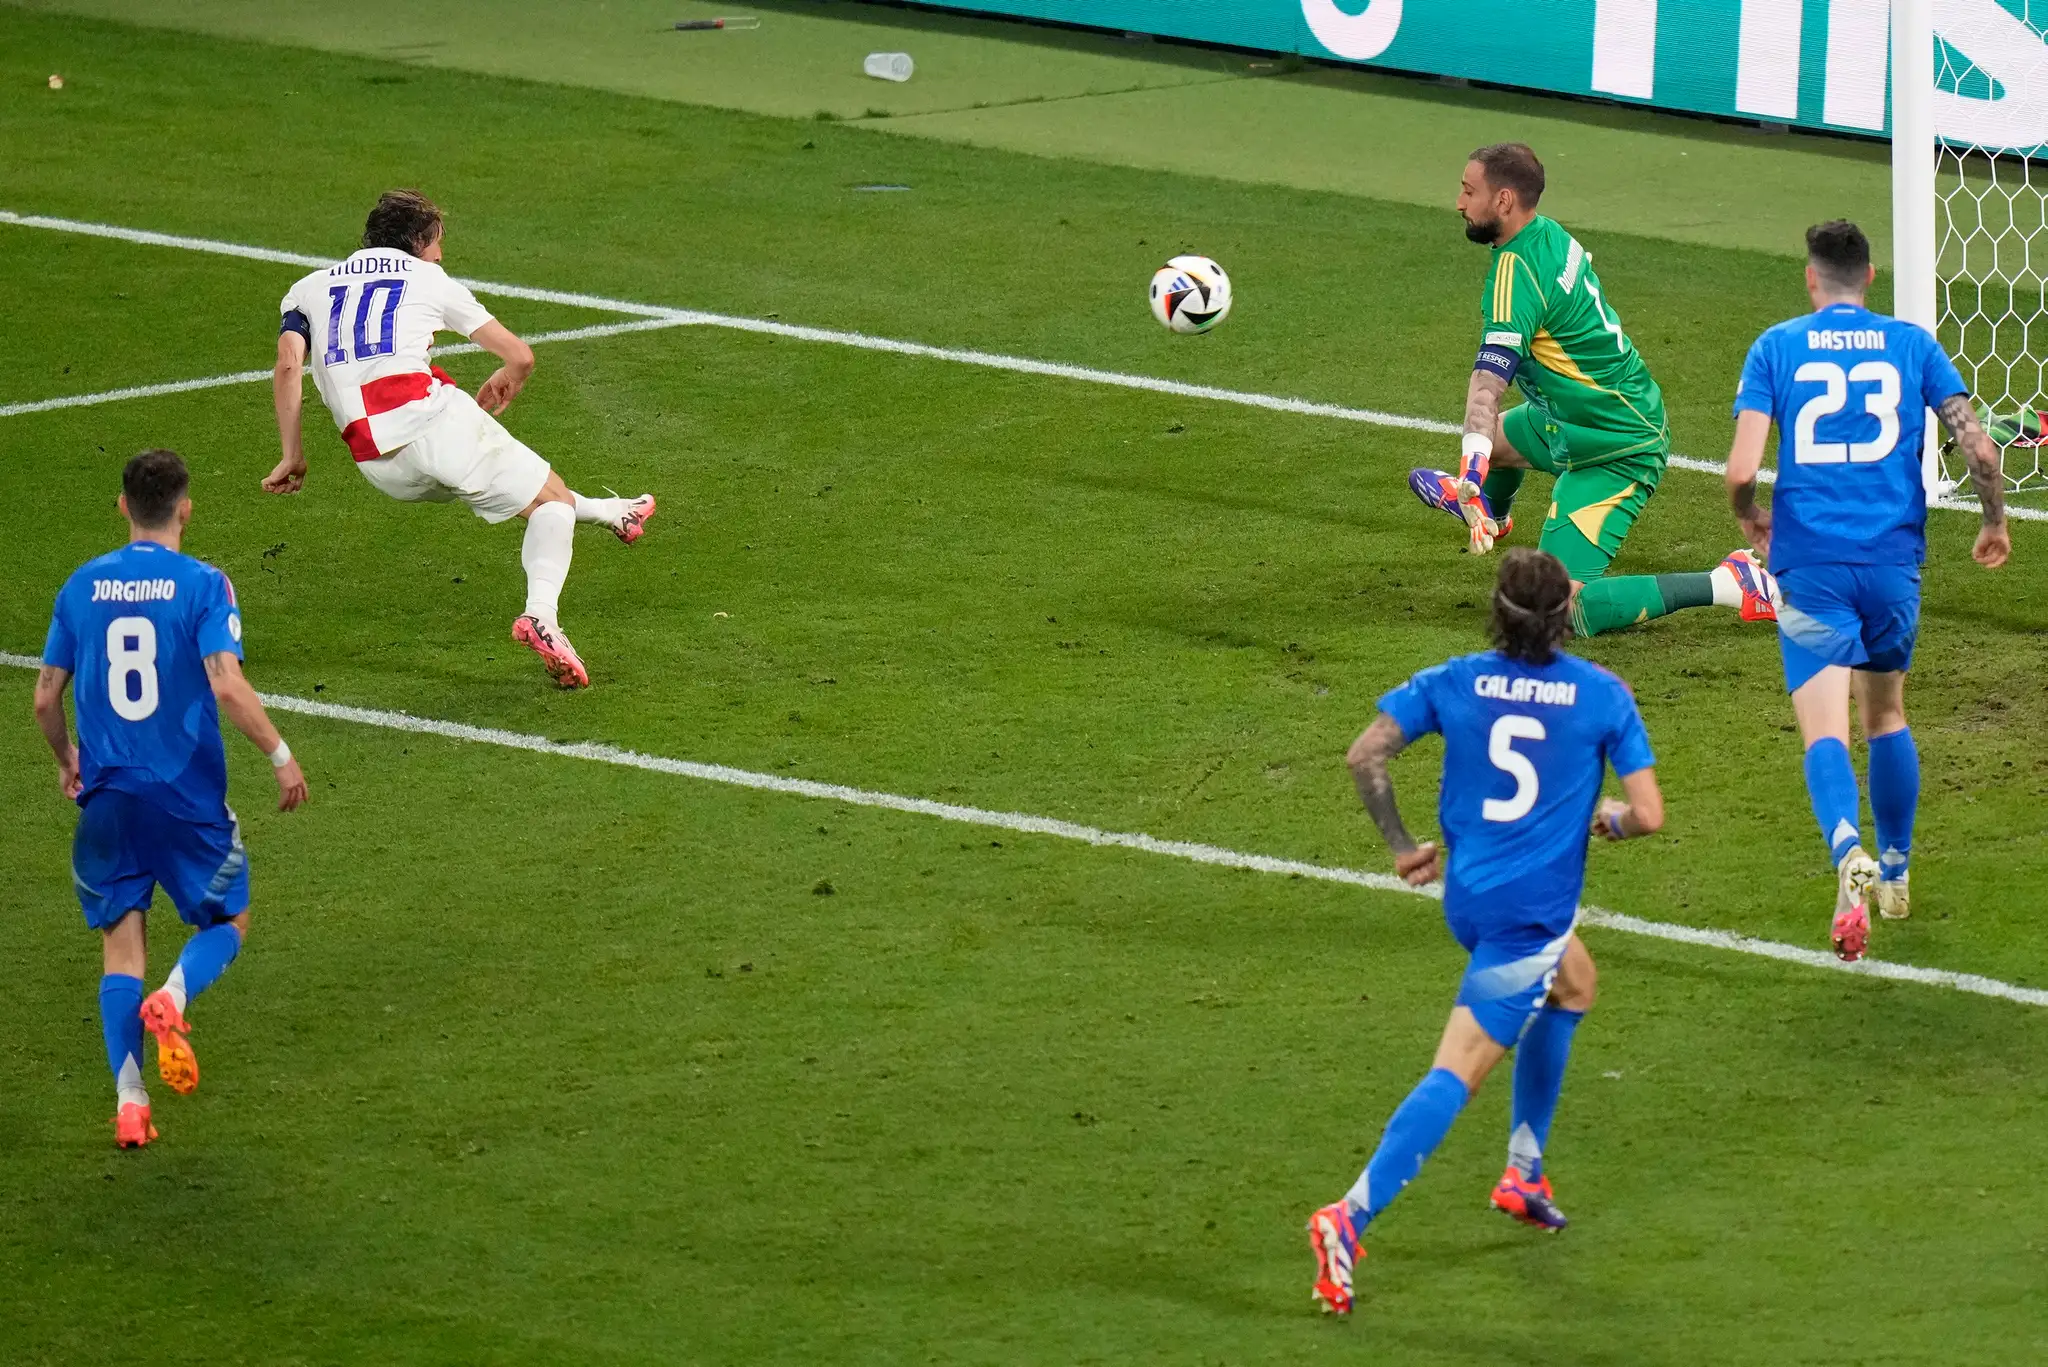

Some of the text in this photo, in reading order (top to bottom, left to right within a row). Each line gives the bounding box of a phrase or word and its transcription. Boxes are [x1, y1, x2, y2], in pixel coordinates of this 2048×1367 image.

[324, 279, 408, 369] 10
[1807, 330, 1886, 350] BASTONI
[1482, 353, 1511, 368] RESPECT
[1794, 361, 1901, 465] 23
[91, 578, 177, 602] JORGINHO
[106, 615, 160, 722] 8
[1474, 674, 1576, 706] CALAFIORI
[1482, 713, 1547, 822] 5
